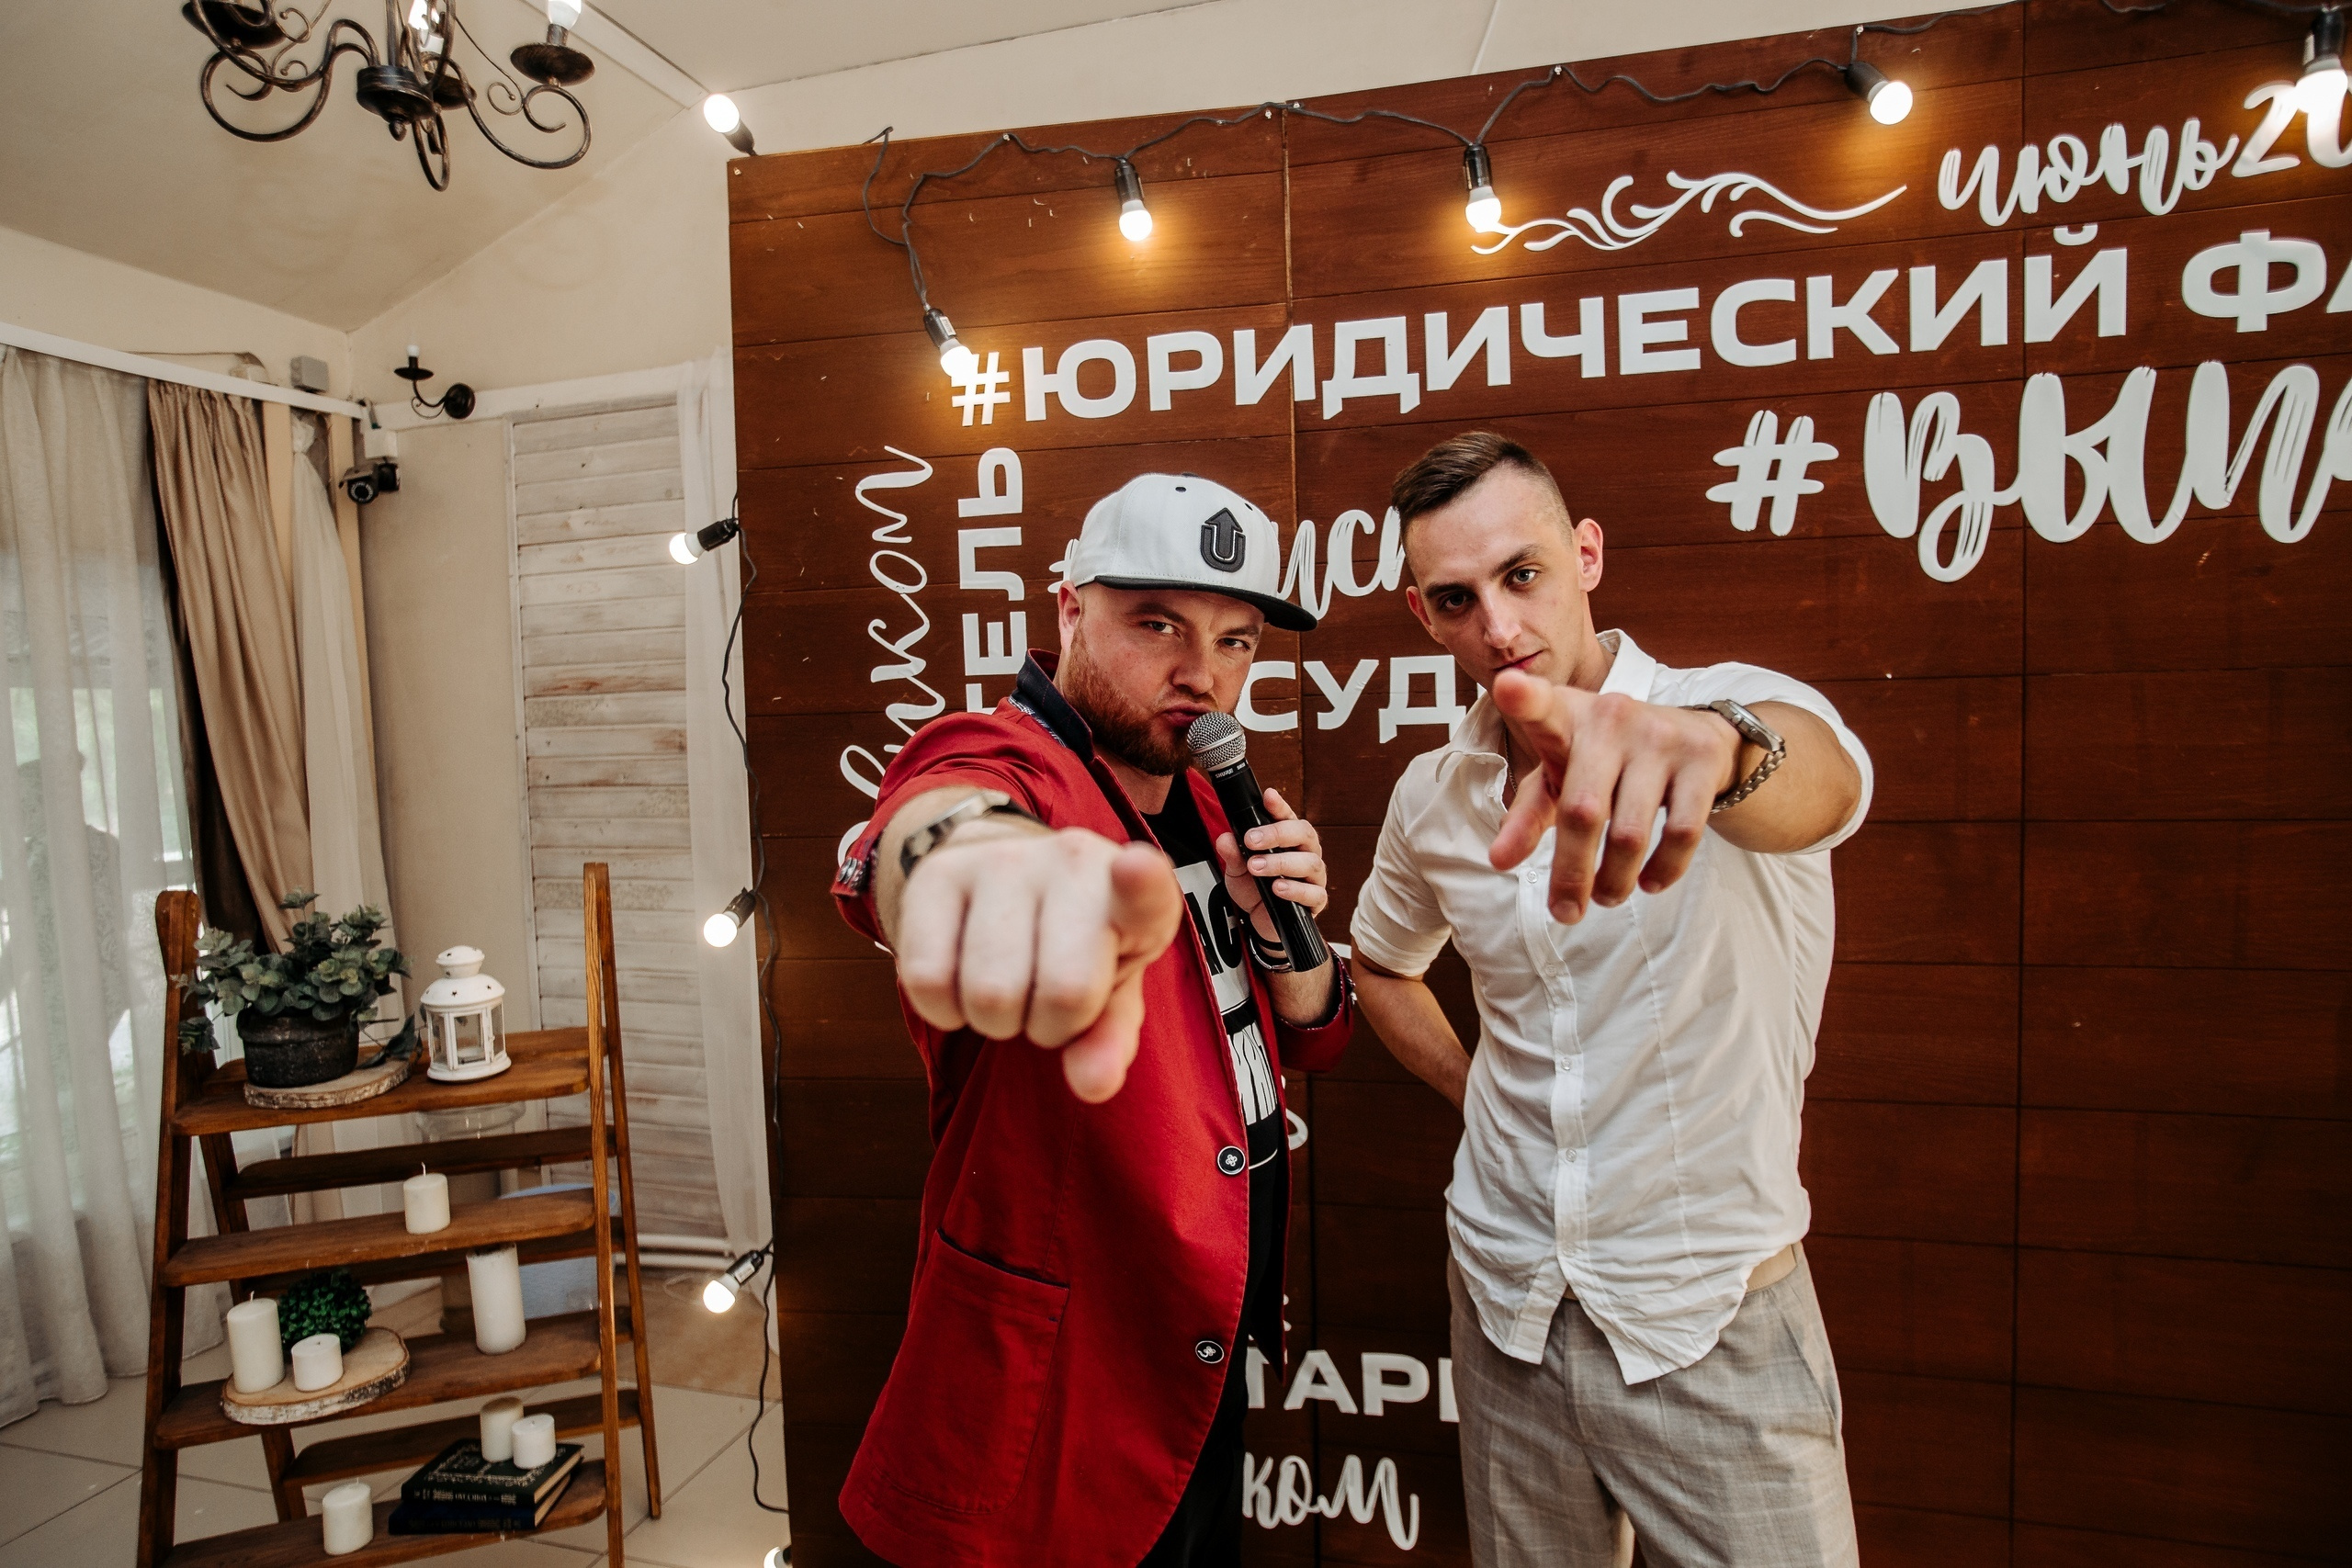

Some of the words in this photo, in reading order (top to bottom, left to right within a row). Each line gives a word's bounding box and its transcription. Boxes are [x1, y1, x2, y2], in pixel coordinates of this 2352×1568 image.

[951, 222, 2127, 427] #ЮРИДИЧЕСКИЙ
[2181, 229, 2352, 333] Ф
[1235, 653, 1487, 745] СУД
[1242, 1451, 1419, 1551] ком
